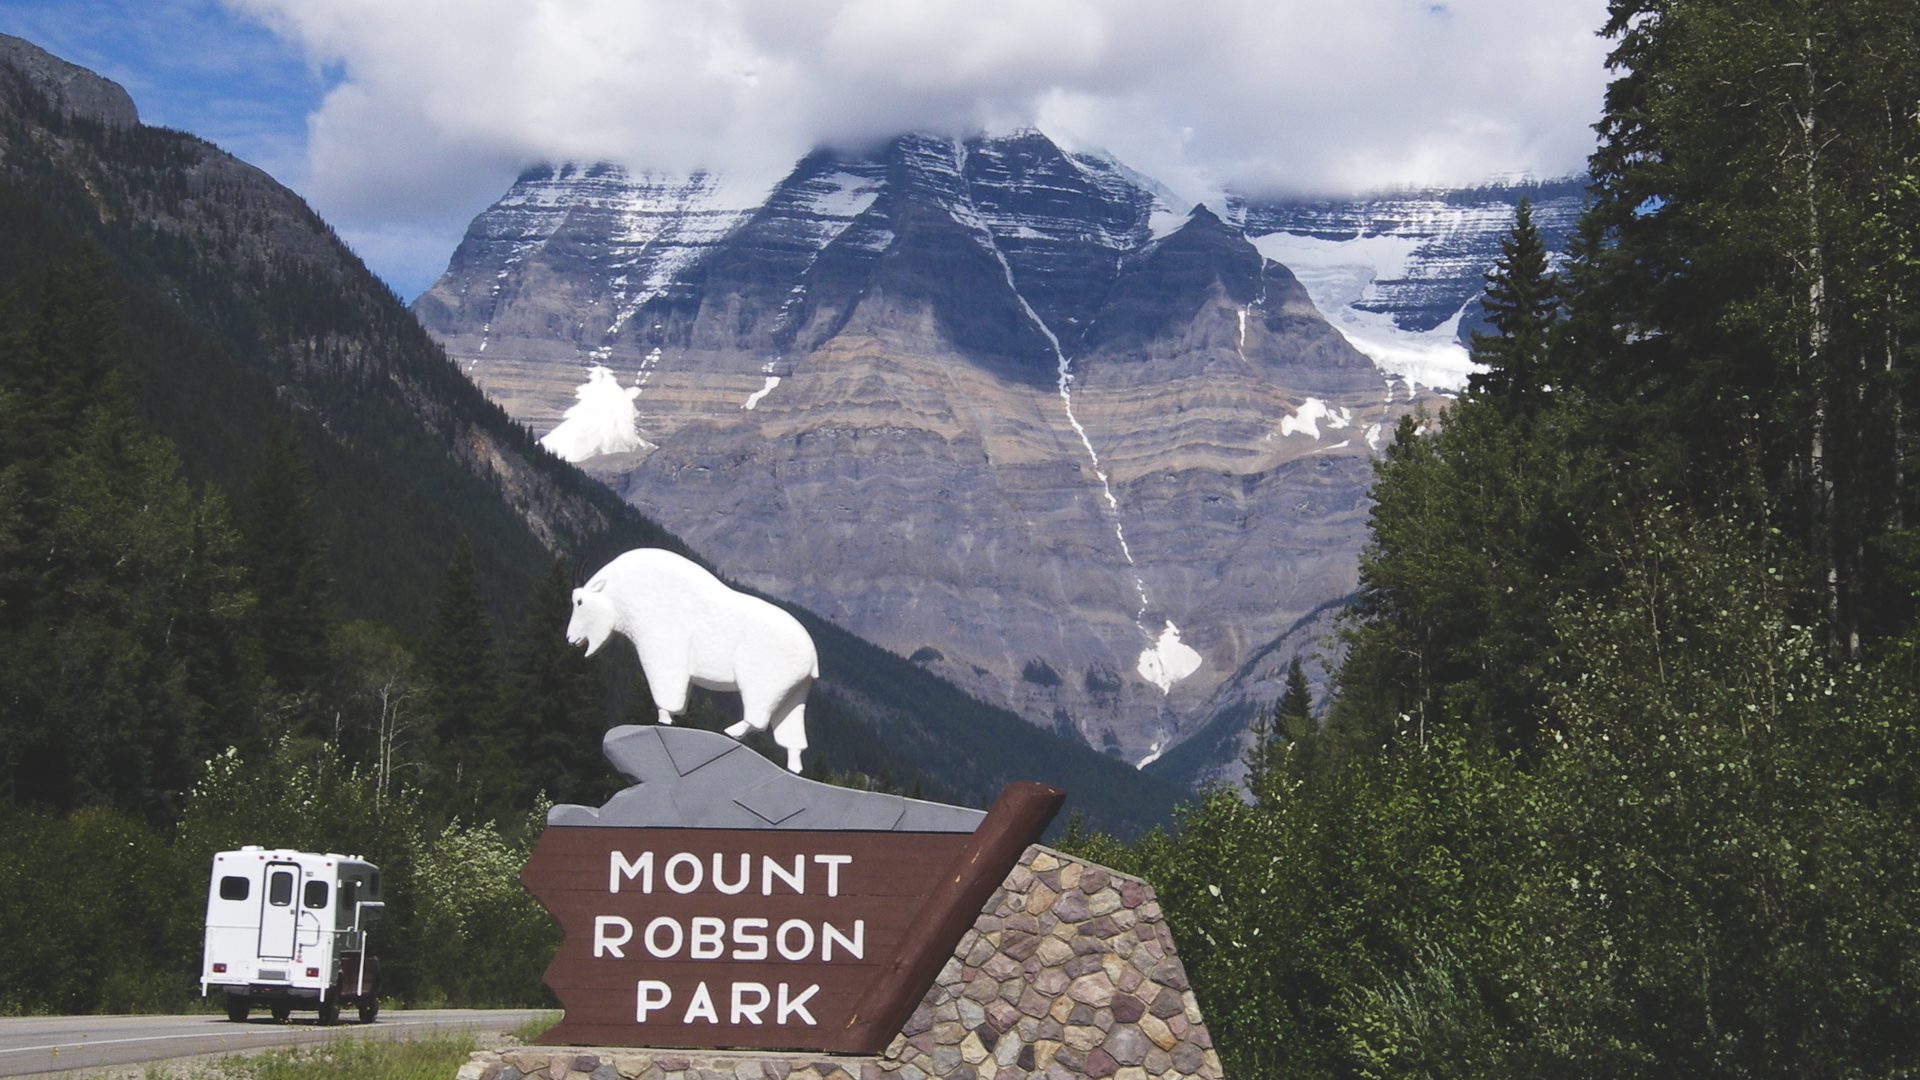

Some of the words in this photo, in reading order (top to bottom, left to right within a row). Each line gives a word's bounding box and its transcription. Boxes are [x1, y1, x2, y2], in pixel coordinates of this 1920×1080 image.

[609, 850, 853, 897] MOUNT
[593, 915, 864, 962] ROBSON
[636, 980, 820, 1026] PARK
